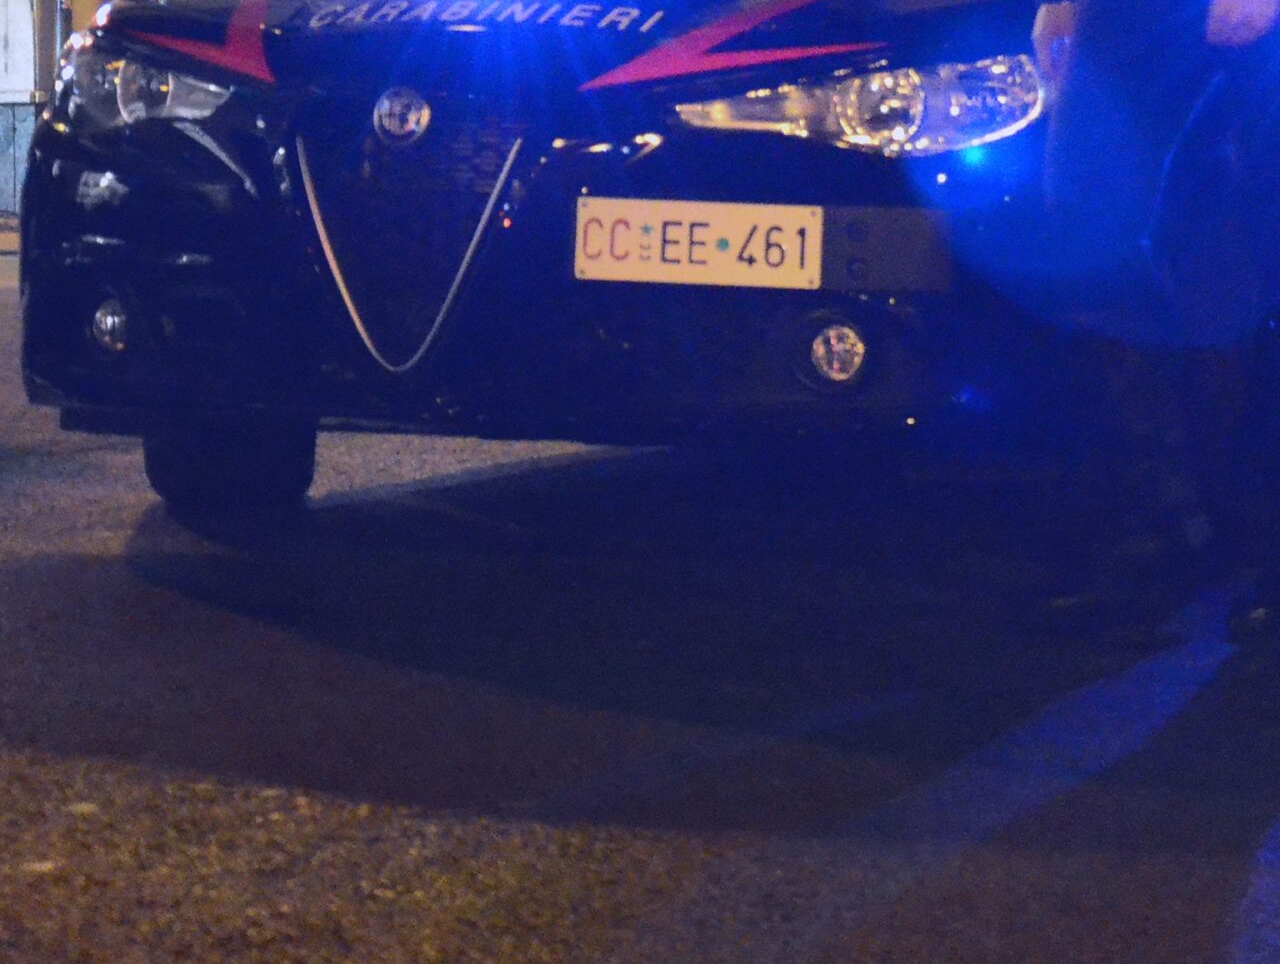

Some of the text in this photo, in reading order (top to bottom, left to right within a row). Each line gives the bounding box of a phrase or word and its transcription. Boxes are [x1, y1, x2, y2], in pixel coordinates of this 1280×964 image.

[307, 0, 665, 32] CARABINIERI
[582, 216, 631, 262] CC
[660, 219, 711, 265] EE
[735, 223, 807, 270] 461
